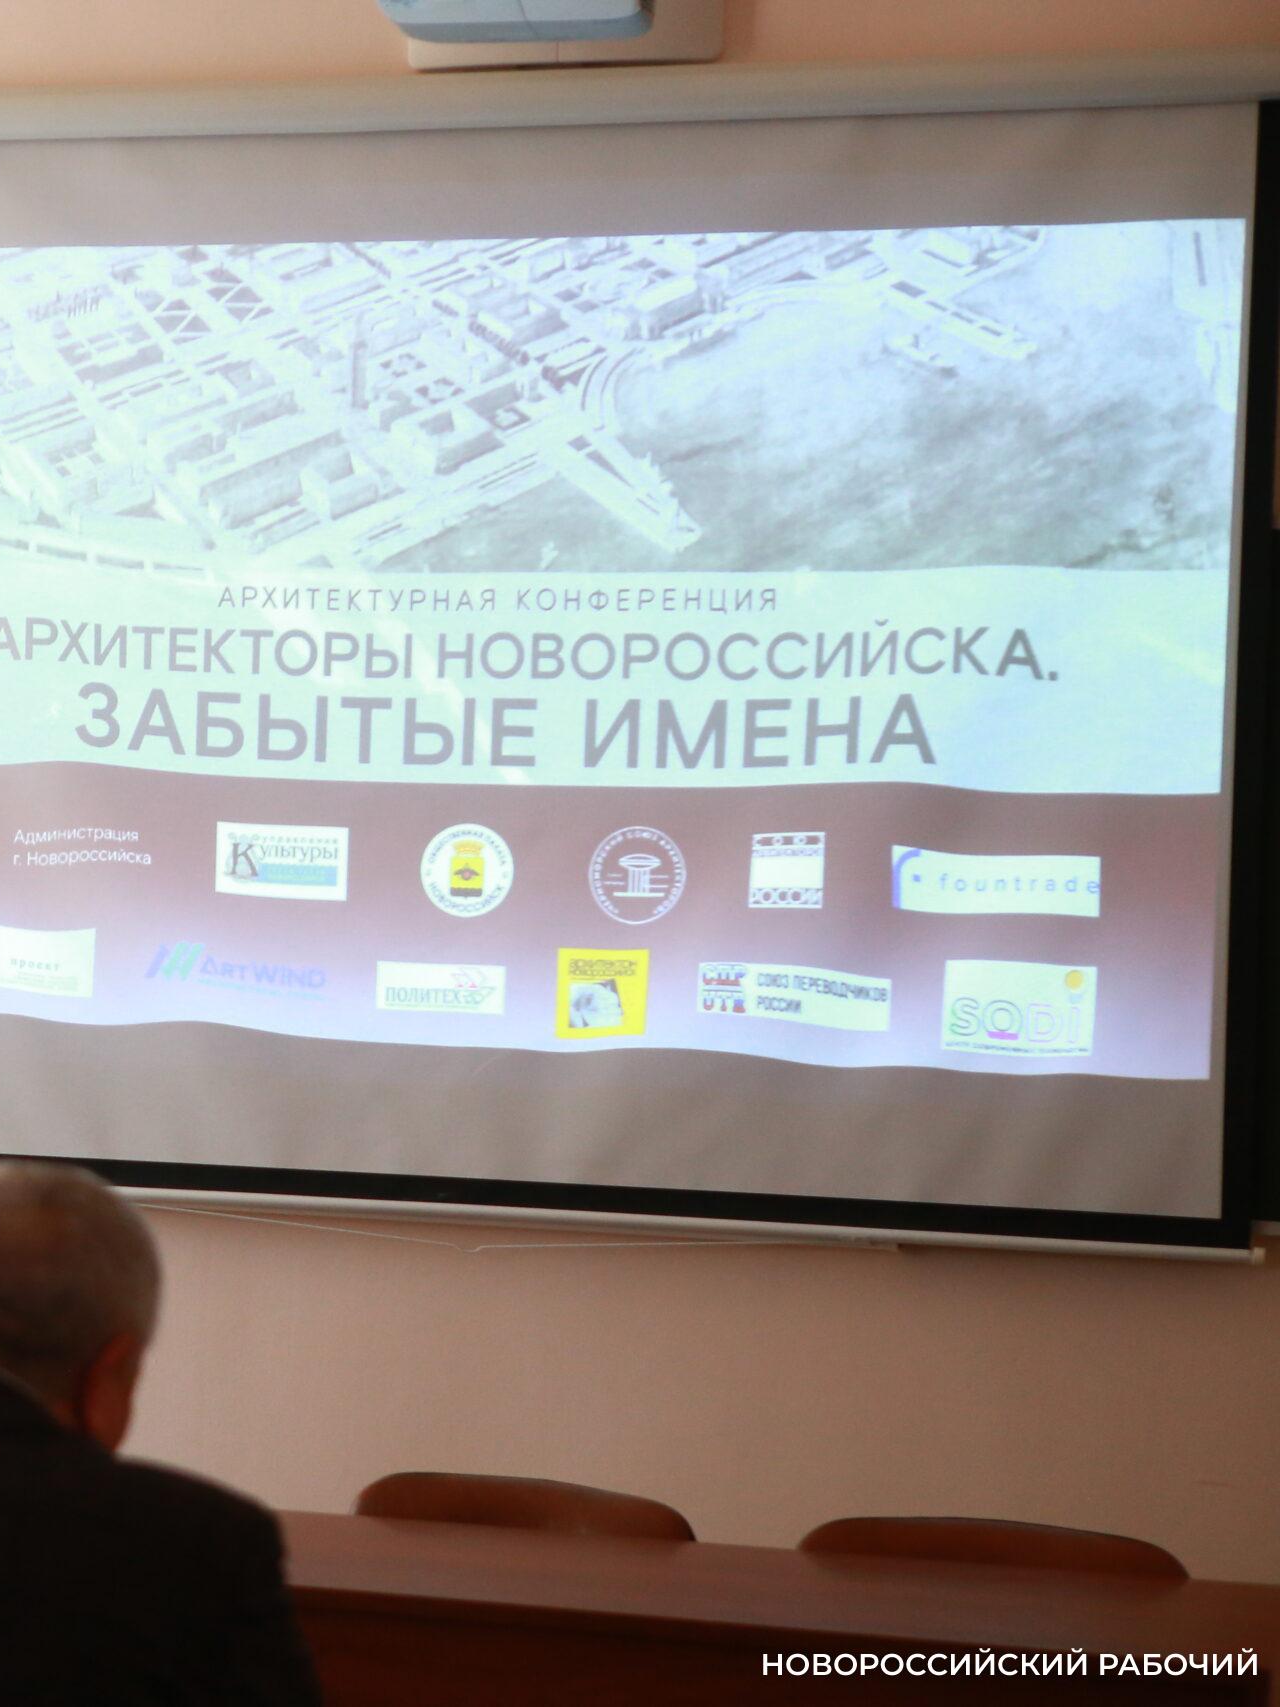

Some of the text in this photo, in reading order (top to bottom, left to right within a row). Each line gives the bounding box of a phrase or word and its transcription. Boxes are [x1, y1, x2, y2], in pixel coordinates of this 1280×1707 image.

[218, 585, 777, 614] АРХИТЕКТУРНАЯ КОНФЕРЕНЦИЯ
[438, 618, 1060, 681] НОВОРОССИЙСКА.
[74, 682, 937, 769] ЗАБЫТЫЕ ИМЕНА
[14, 827, 140, 846] Администрация
[13, 848, 152, 867] г. Новороссийска
[939, 873, 1100, 894] fountrade
